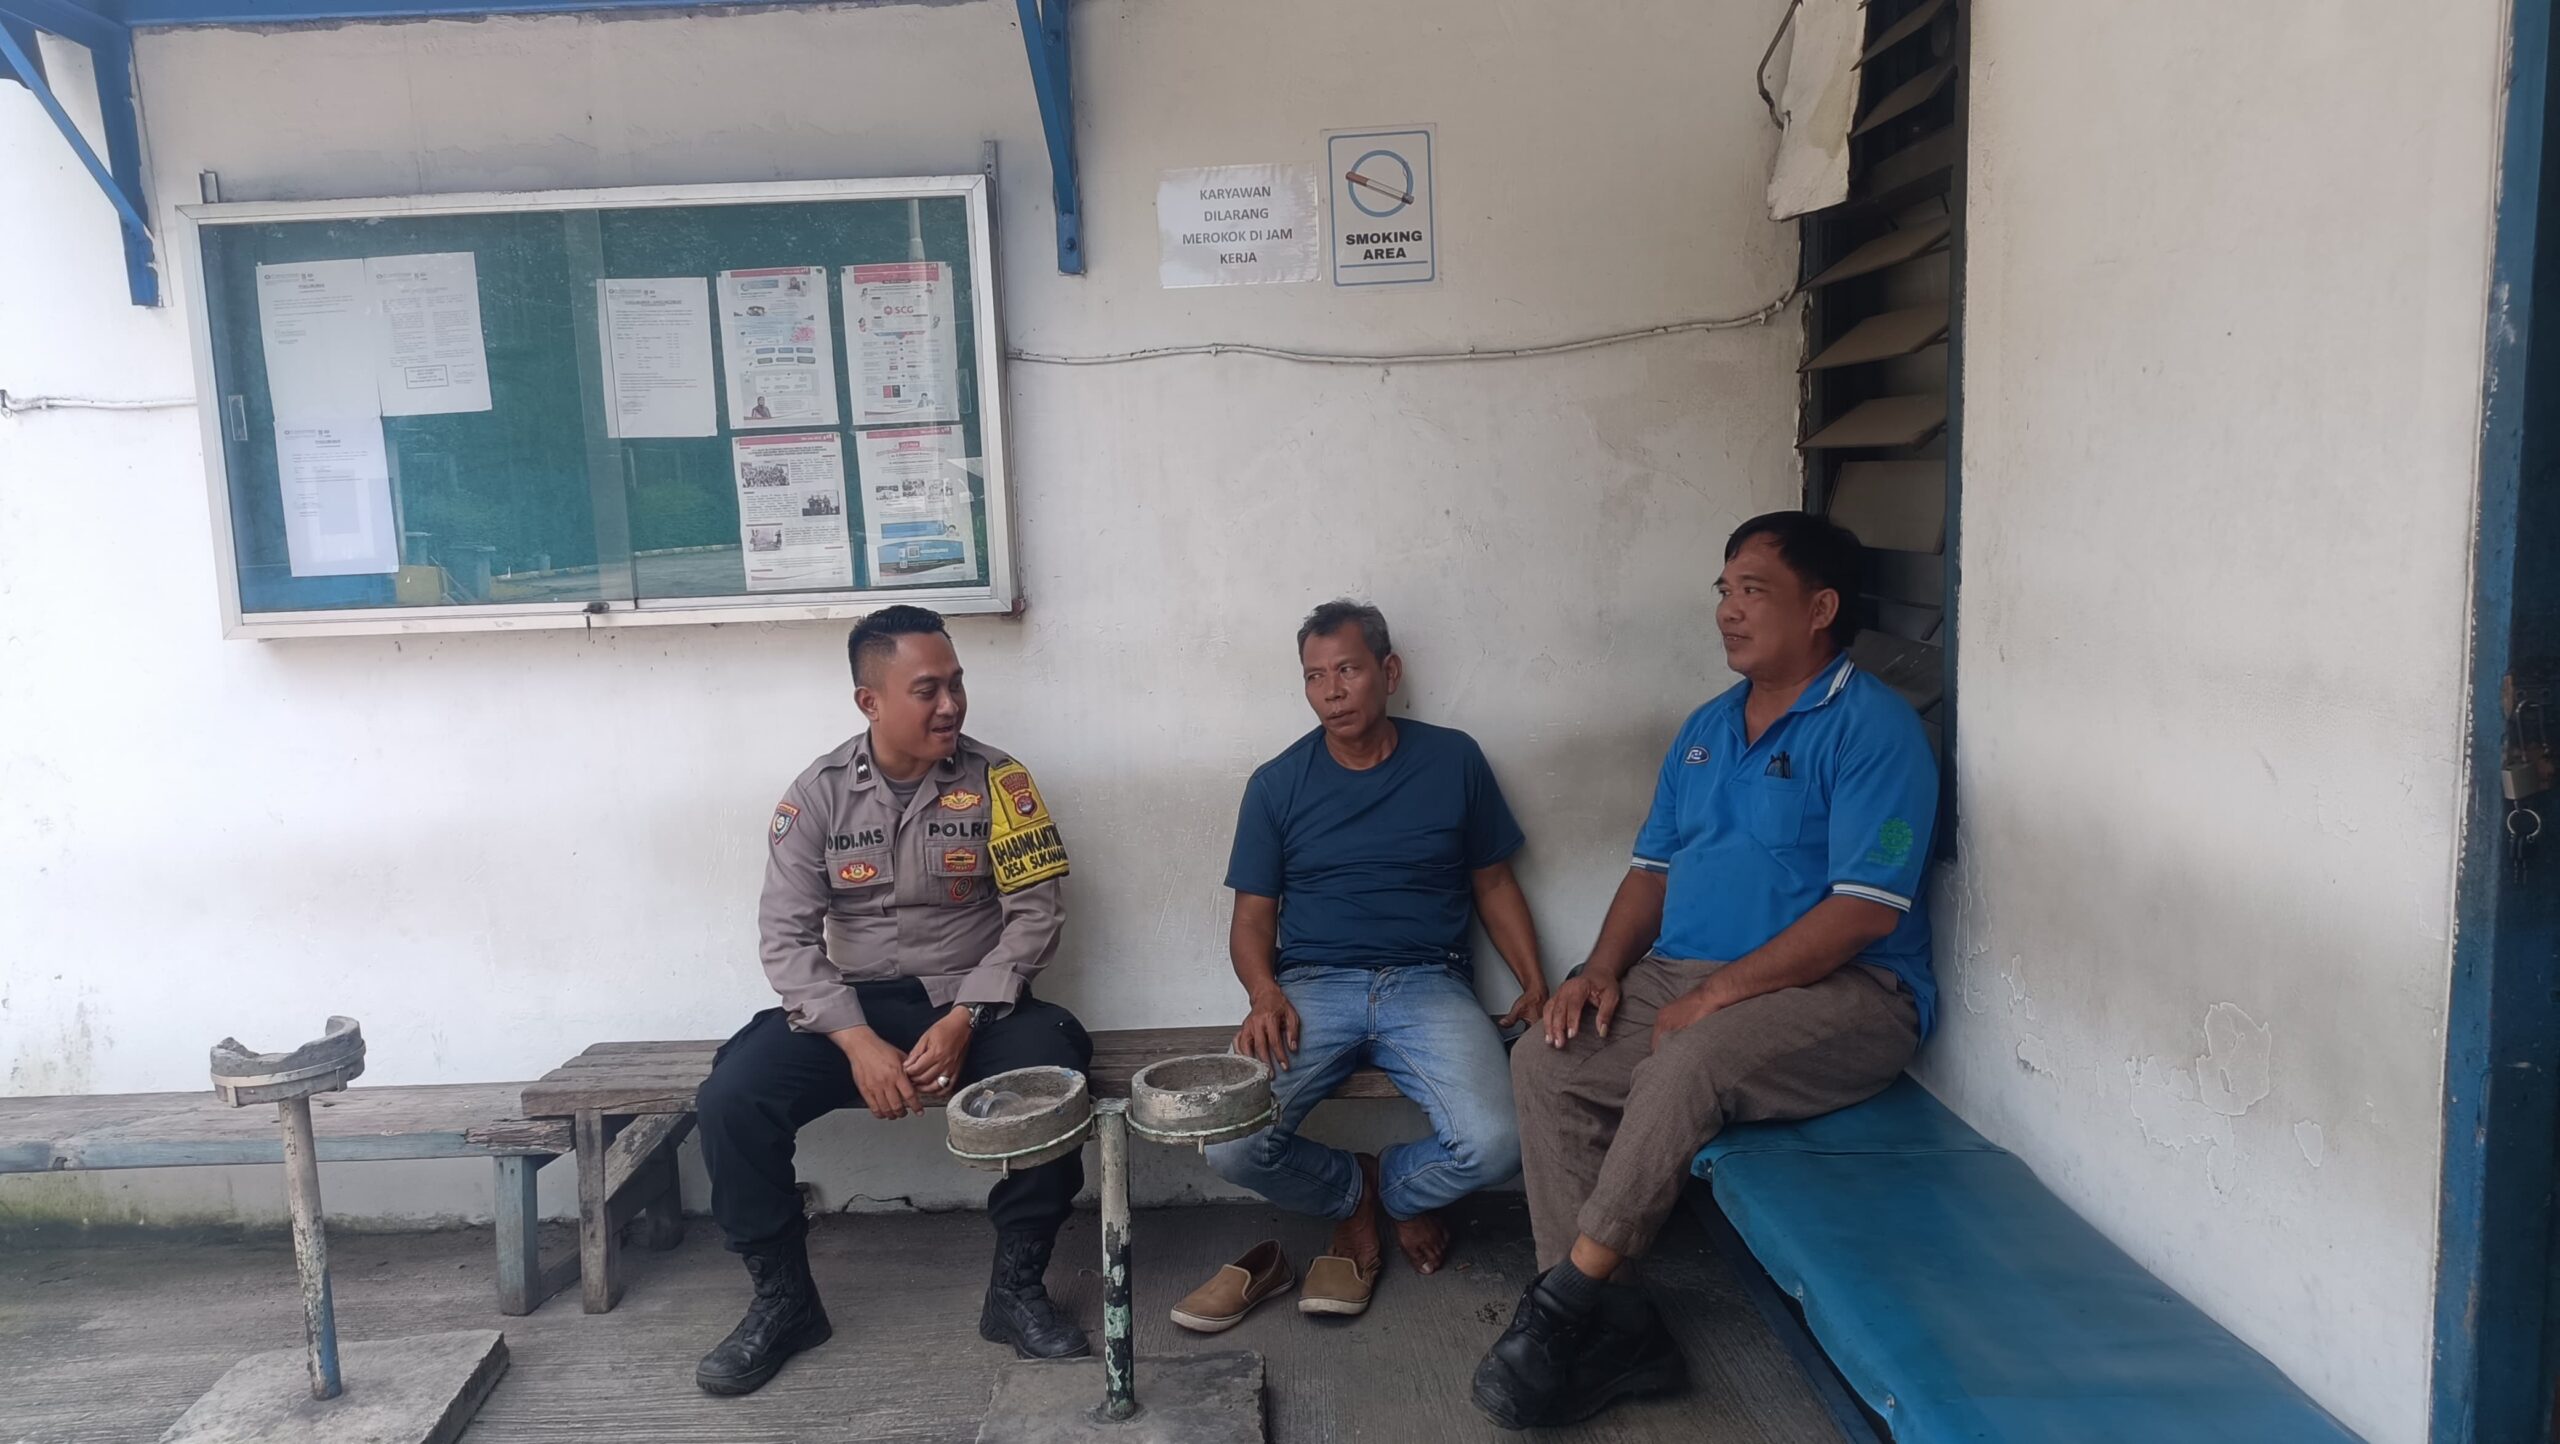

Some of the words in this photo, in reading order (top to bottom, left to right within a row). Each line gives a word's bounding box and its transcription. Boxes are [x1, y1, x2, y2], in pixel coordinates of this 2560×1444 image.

[1199, 186, 1272, 201] KARYAWAN
[1203, 207, 1270, 223] DILARANG
[1182, 230, 1247, 246] MEROKOK
[1249, 229, 1263, 242] DI
[1265, 228, 1294, 242] JAM
[1345, 230, 1423, 246] SMOKING
[1219, 251, 1258, 265] KERJA
[1363, 247, 1407, 261] AREA
[894, 305, 915, 315] SCG
[928, 821, 989, 838] POLRI
[1002, 859, 1028, 880] DESA
